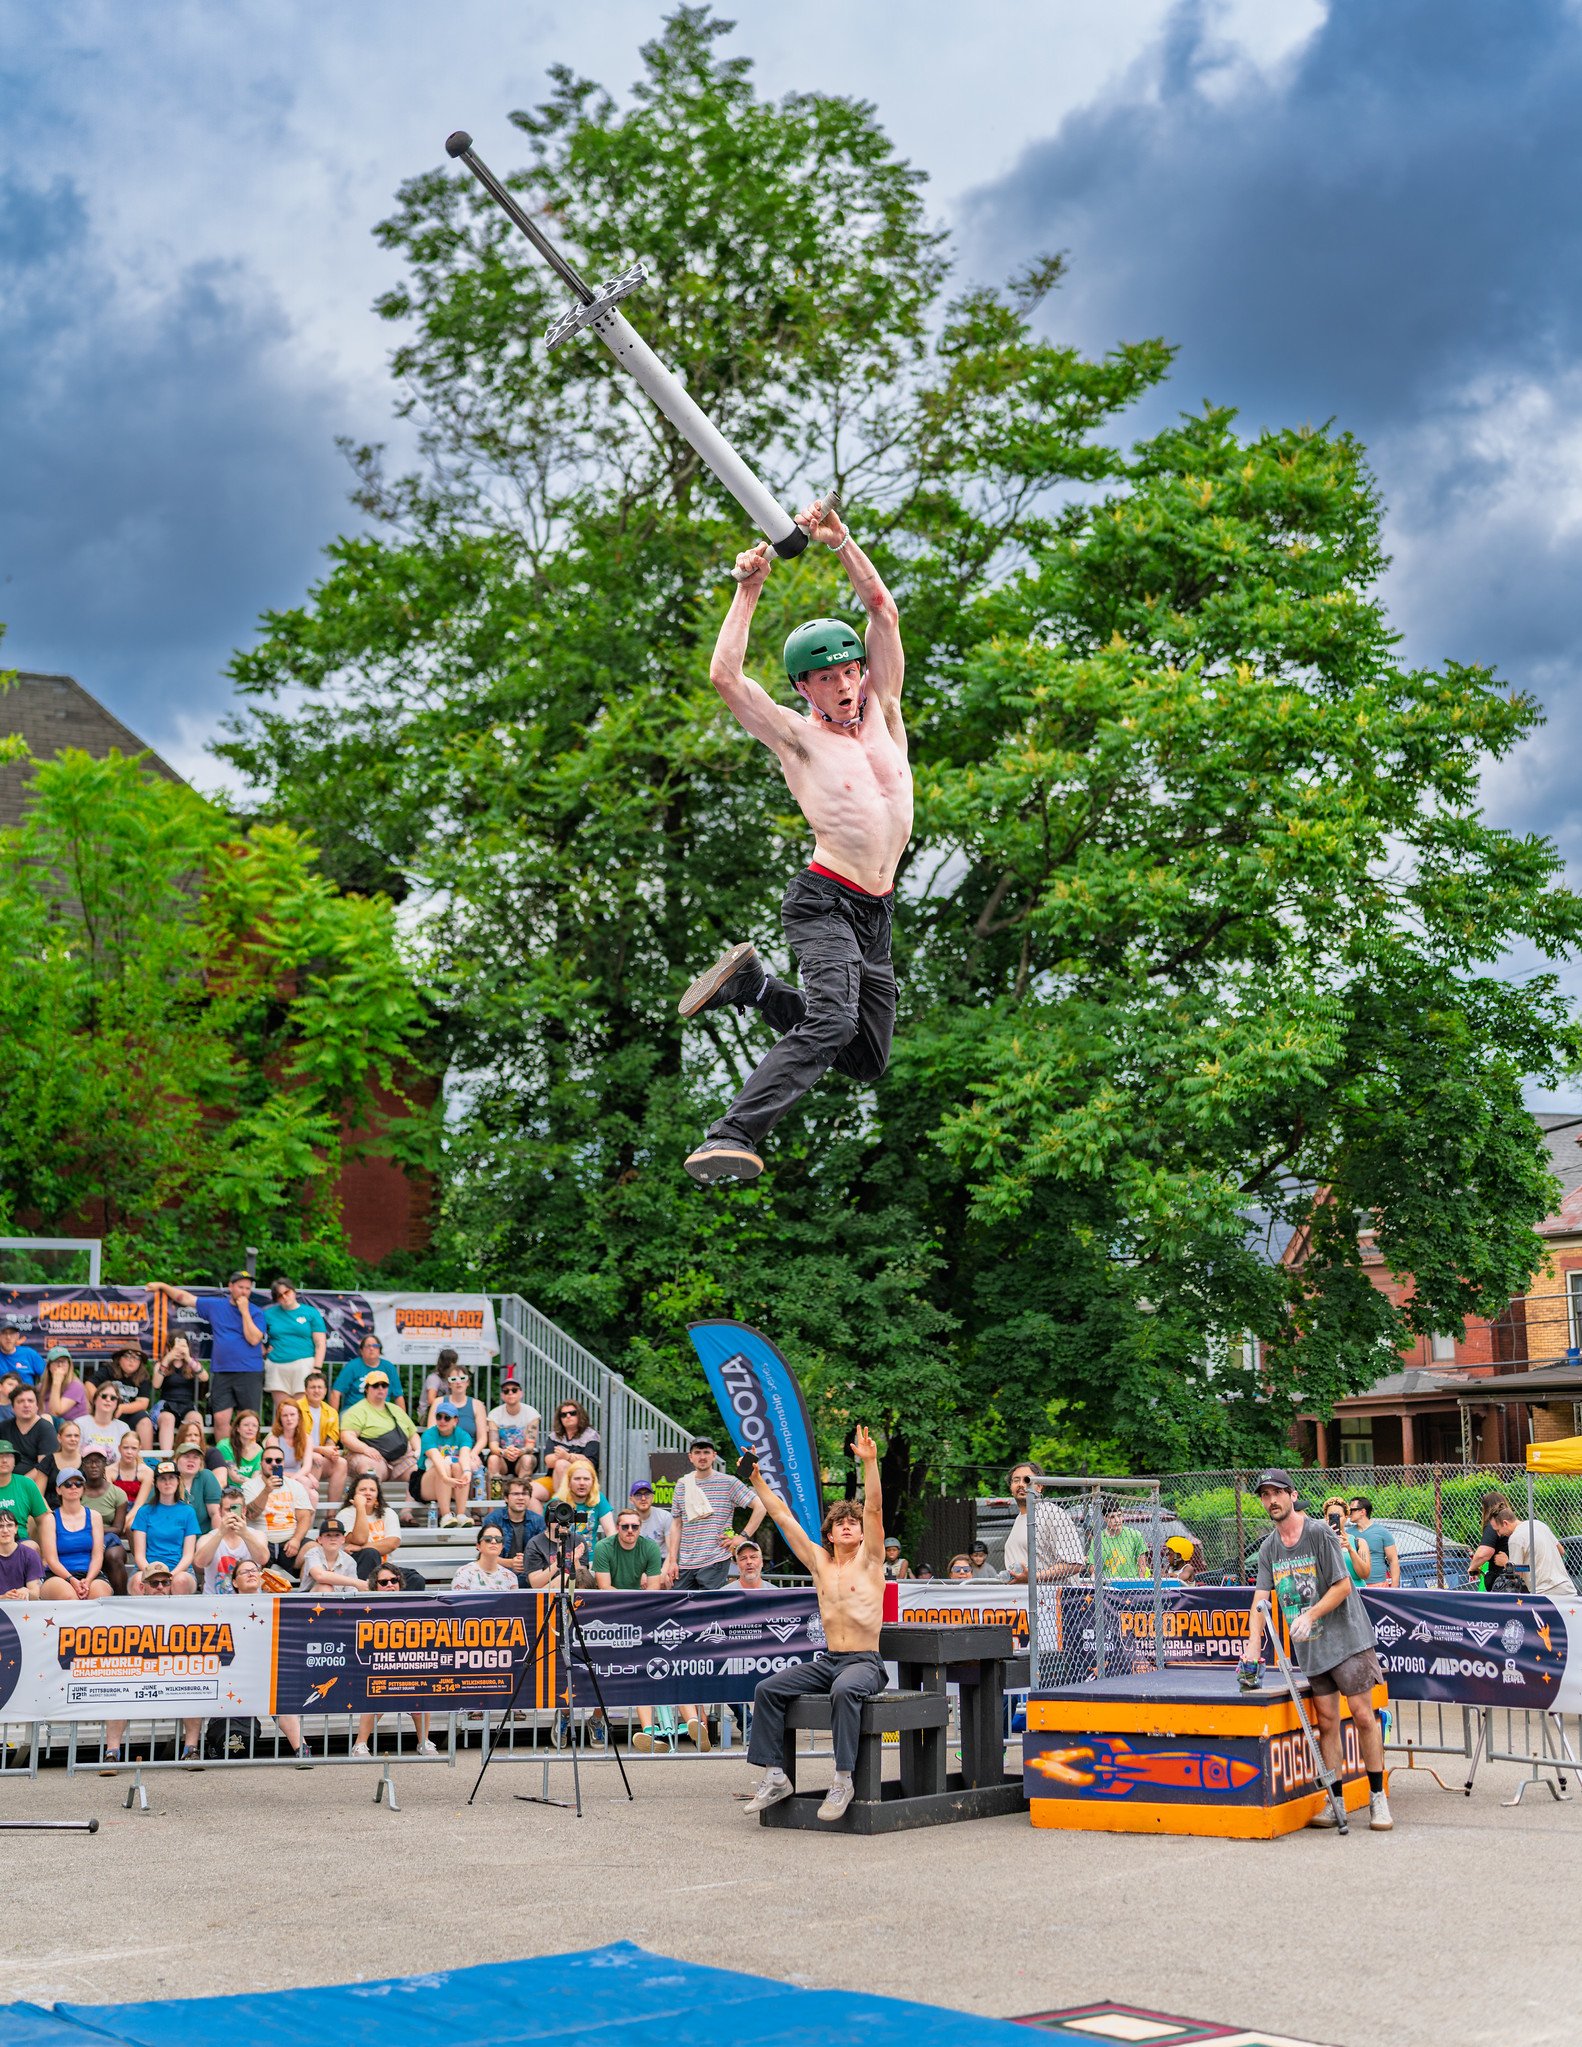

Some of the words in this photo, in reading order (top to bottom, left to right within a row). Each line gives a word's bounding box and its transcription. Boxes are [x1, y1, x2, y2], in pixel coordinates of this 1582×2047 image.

[39, 1301, 148, 1321] POGOPALOOZA
[101, 1321, 139, 1335] POGO
[762, 1362, 778, 1392] Series
[773, 1393, 799, 1470] Championship
[793, 1469, 806, 1504] World
[1120, 1611, 1255, 1638] POOPALOOZ
[59, 1624, 233, 1656] POGOPALOOZA
[358, 1619, 526, 1650] POGOPALOOZA
[1135, 1640, 1154, 1649] THE
[1194, 1642, 1205, 1653] OF
[1206, 1640, 1250, 1657] POG
[75, 1657, 98, 1669] THE
[100, 1656, 142, 1668] WORLD
[144, 1660, 157, 1672] OF
[158, 1654, 220, 1676] POGO
[306, 1656, 346, 1667] @XPOGO
[373, 1652, 396, 1663] THE
[397, 1651, 438, 1662] WORLD
[440, 1654, 453, 1665] OF
[455, 1650, 512, 1668] POGO
[1390, 1656, 1426, 1674] XPOGO
[73, 1667, 142, 1677] CHAMPIONSHIPS
[372, 1662, 439, 1671] CHAMPIONSHIPS
[672, 1658, 714, 1676] XPOGO
[72, 1692, 87, 1700] 12th
[134, 1690, 164, 1699] 13-14th
